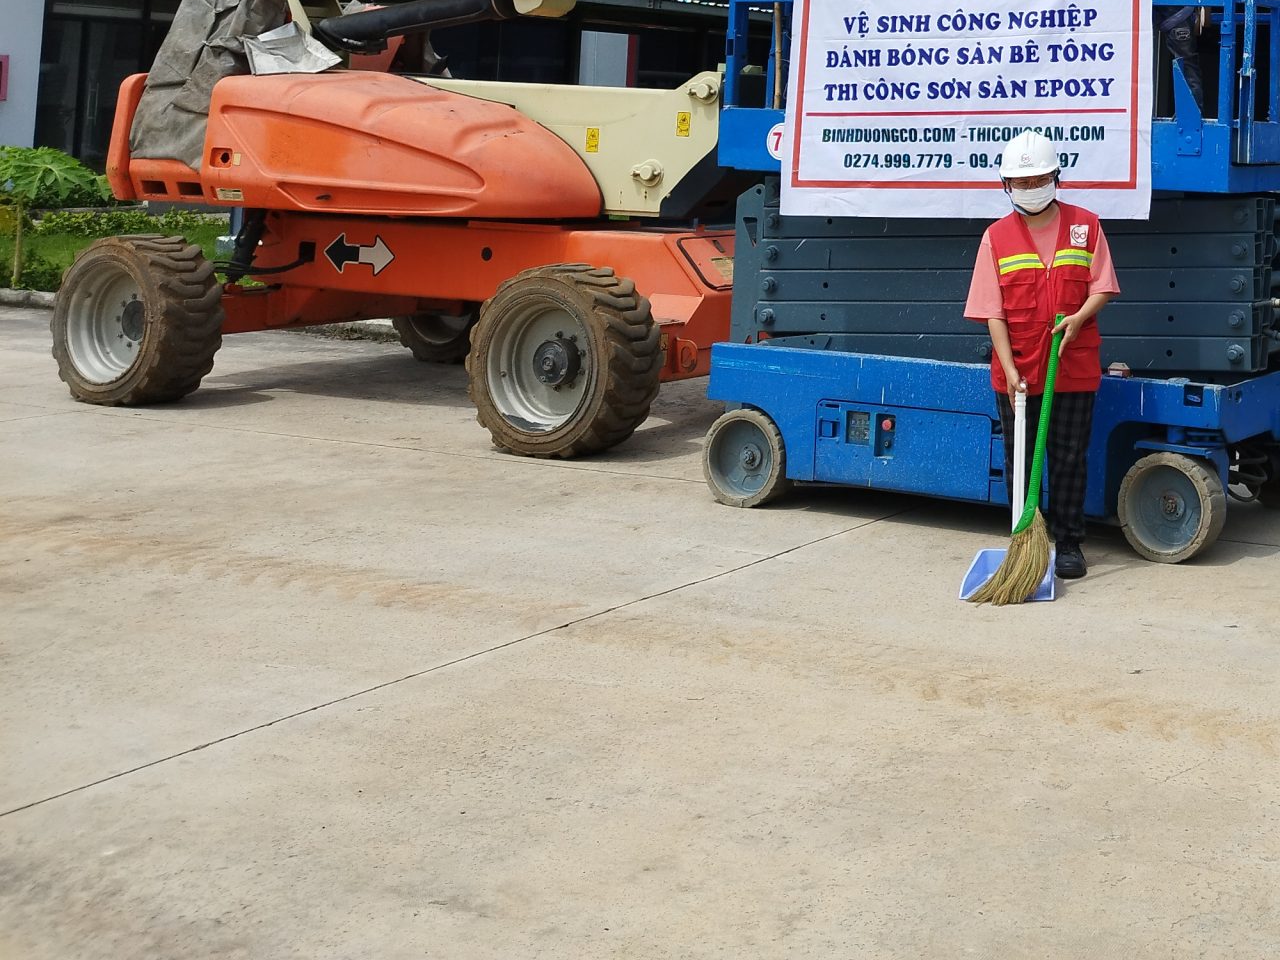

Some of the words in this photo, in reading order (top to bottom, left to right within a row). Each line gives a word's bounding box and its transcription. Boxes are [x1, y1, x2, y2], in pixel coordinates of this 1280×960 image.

[844, 11, 870, 38] VỆ
[876, 14, 931, 33] SINH
[936, 9, 1002, 32] CÔNG
[1007, 3, 1098, 32] NGHIỆP
[825, 45, 882, 68] ĐÁNH
[886, 43, 951, 67] BÓNG
[956, 41, 1004, 65] SÀN
[1008, 39, 1040, 64] BÊ
[1046, 38, 1115, 63] TÔNG
[823, 83, 858, 101] THI
[862, 78, 921, 101] CÔNG
[926, 77, 972, 100] SƠN
[977, 74, 1028, 99] SÀN
[1034, 77, 1115, 98] EPOXY
[772, 131, 783, 152] 7
[822, 127, 956, 143] BINHDUONGCO.COM
[843, 153, 952, 169] 0274.999.7779
